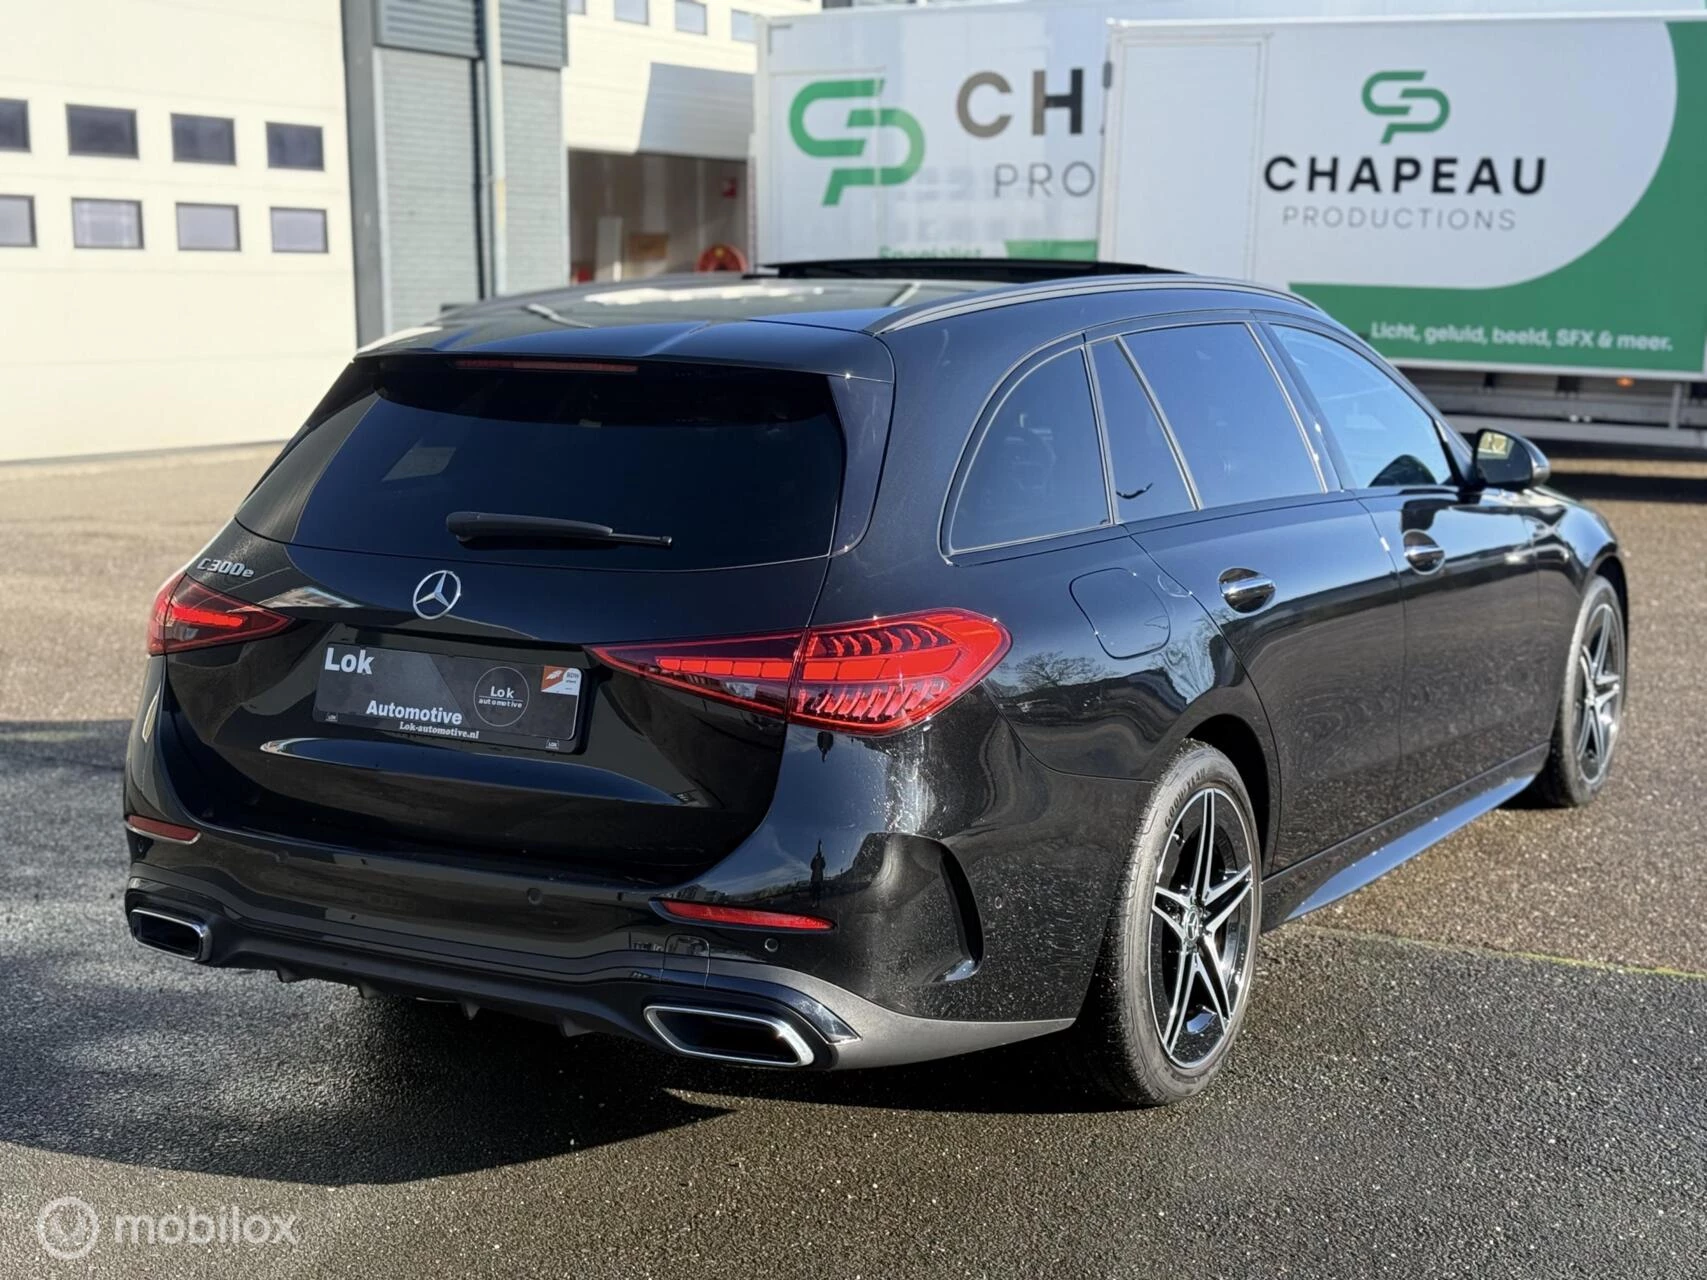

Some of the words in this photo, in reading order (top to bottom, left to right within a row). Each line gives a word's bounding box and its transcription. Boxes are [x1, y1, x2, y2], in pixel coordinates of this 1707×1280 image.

[956, 68, 1104, 138] CH
[994, 161, 1096, 198] PRO
[1264, 155, 1546, 195] CHAPEAU
[1282, 205, 1517, 231] PRODUCTIONS
[1370, 321, 1421, 343] Licht,
[1424, 323, 1488, 346] geluid,
[1491, 326, 1552, 348] beeld,
[1555, 329, 1595, 348] SFX
[1597, 330, 1613, 348] &
[1616, 333, 1674, 351] meer.
[197, 557, 255, 578] C300e
[324, 647, 375, 675] Lok
[478, 698, 523, 709] automotive
[490, 685, 515, 699] Lok
[366, 699, 463, 725] Automotive
[399, 720, 480, 740] Lok-automotive.nl
